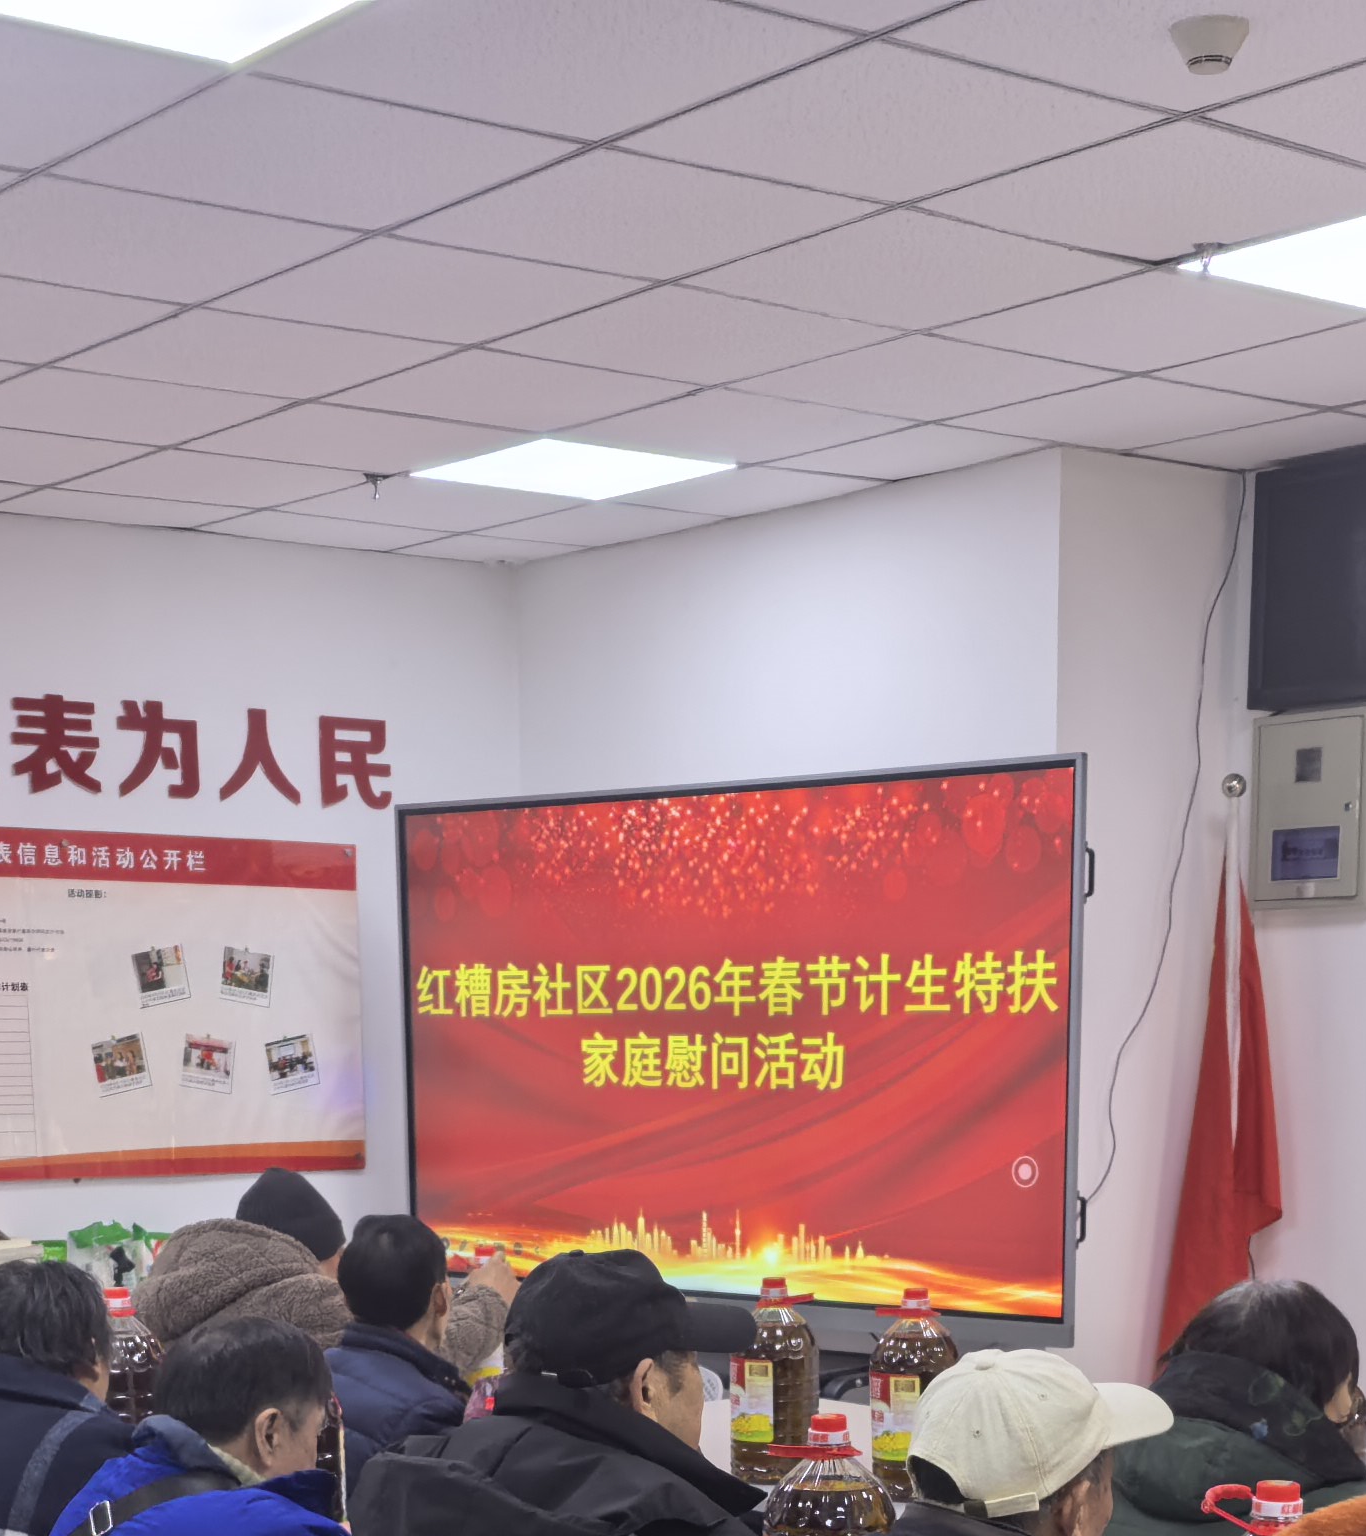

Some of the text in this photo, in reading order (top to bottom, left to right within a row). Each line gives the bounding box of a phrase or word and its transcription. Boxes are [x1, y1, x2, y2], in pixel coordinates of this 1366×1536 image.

[416, 949, 1059, 1018] 红糟房社区2026年春节计生特扶
[581, 1032, 845, 1090] 家庭慰问活动
